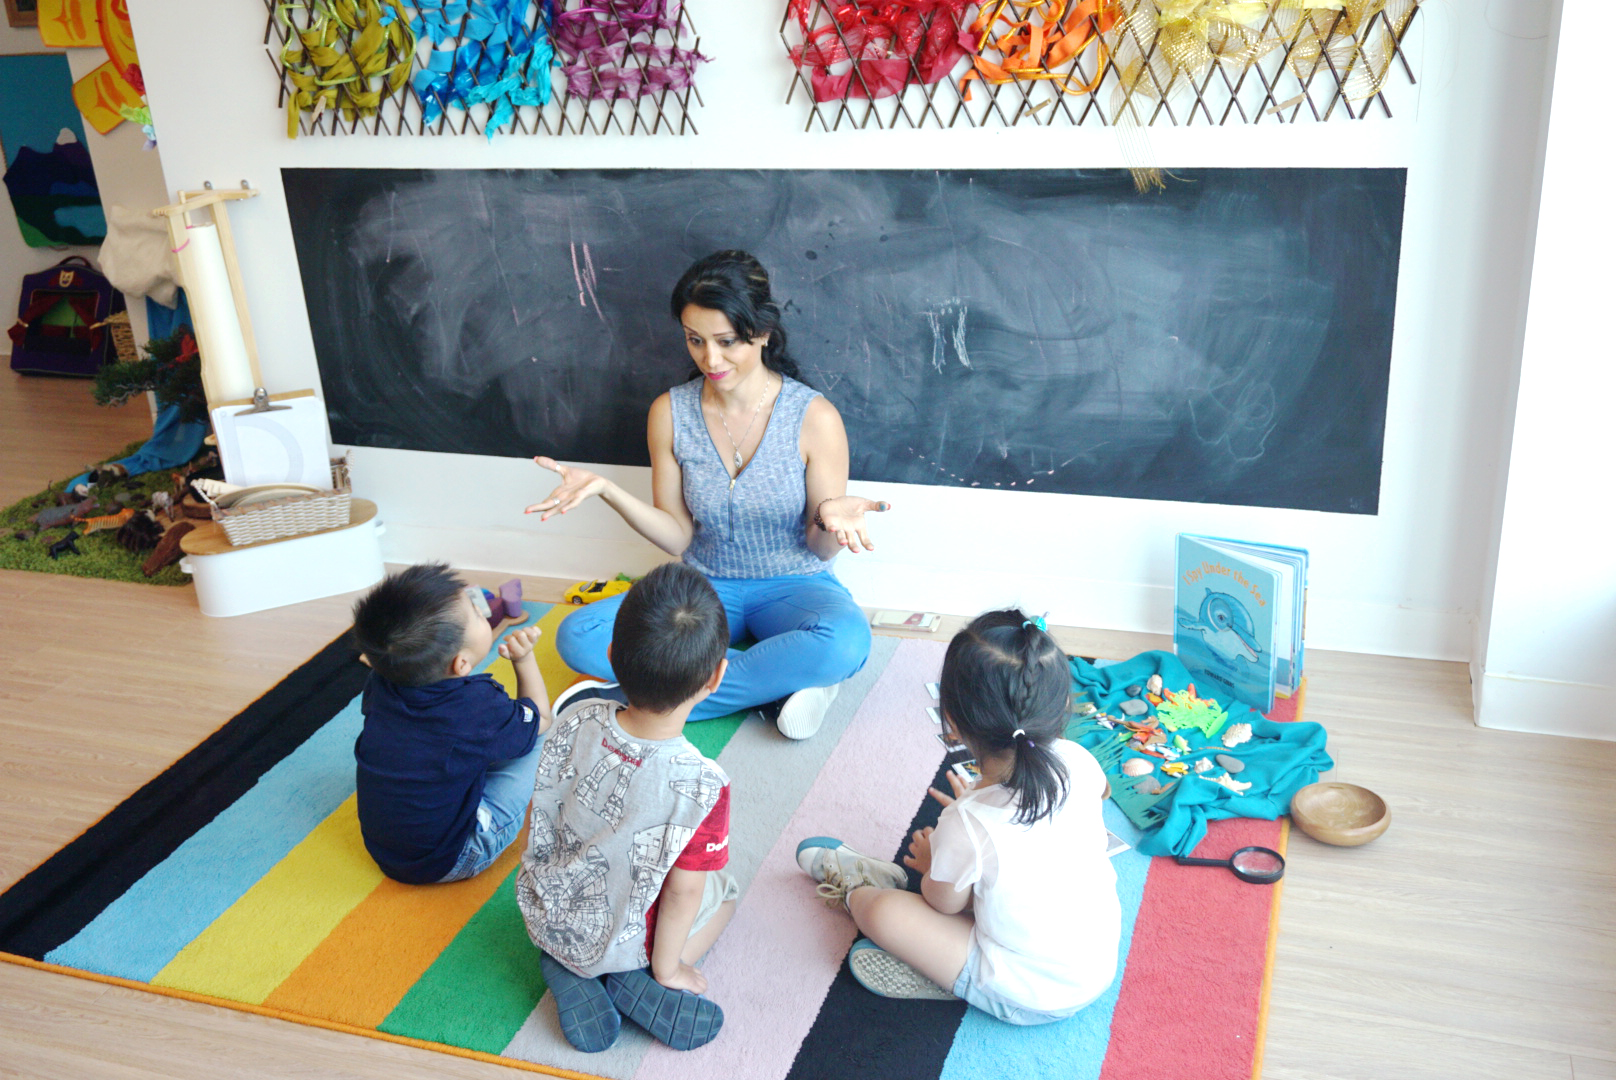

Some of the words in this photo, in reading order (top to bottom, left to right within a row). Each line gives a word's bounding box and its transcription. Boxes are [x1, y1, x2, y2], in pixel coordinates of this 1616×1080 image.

[1186, 567, 1204, 583] Spy
[1201, 561, 1232, 576] Under
[1182, 575, 1192, 586] I
[1233, 570, 1250, 589] the
[1249, 584, 1267, 607] Sea
